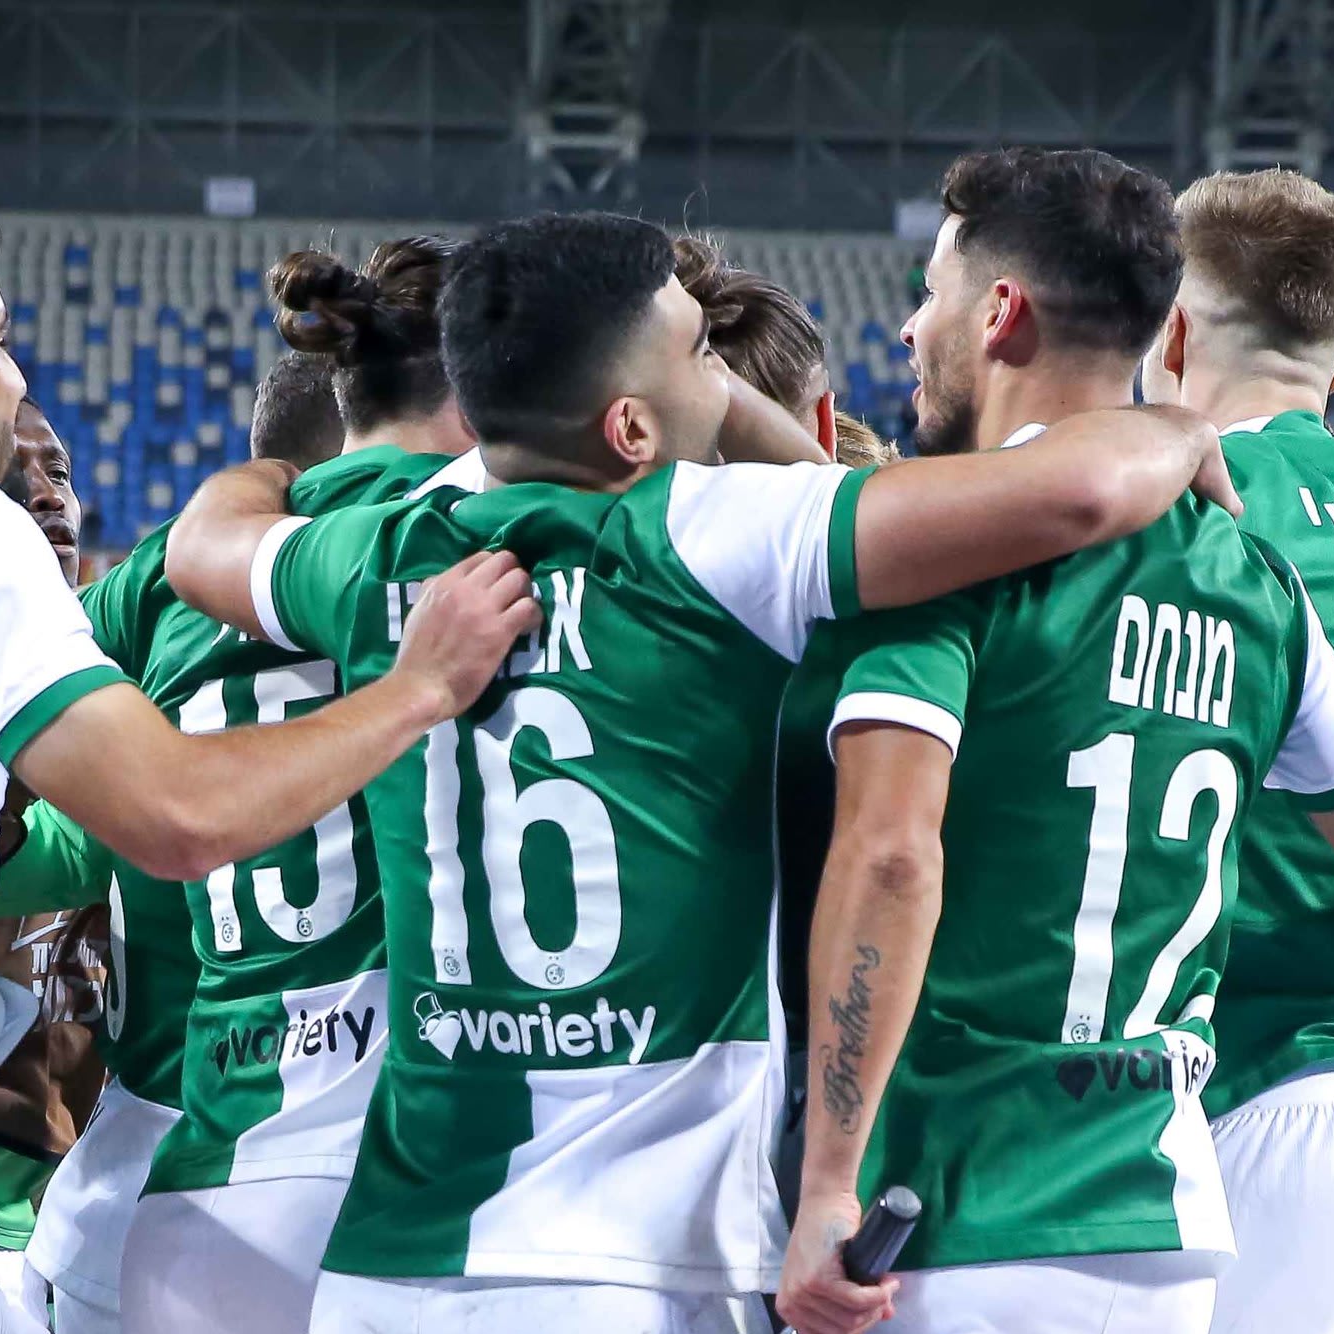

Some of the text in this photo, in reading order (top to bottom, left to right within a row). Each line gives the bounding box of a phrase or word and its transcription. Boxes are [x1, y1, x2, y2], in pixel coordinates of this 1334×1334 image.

[1108, 593, 1237, 729] מנחם
[423, 685, 623, 991] 16
[1060, 731, 1239, 1045] 12
[230, 1004, 377, 1064] variety
[460, 996, 657, 1065] variety
